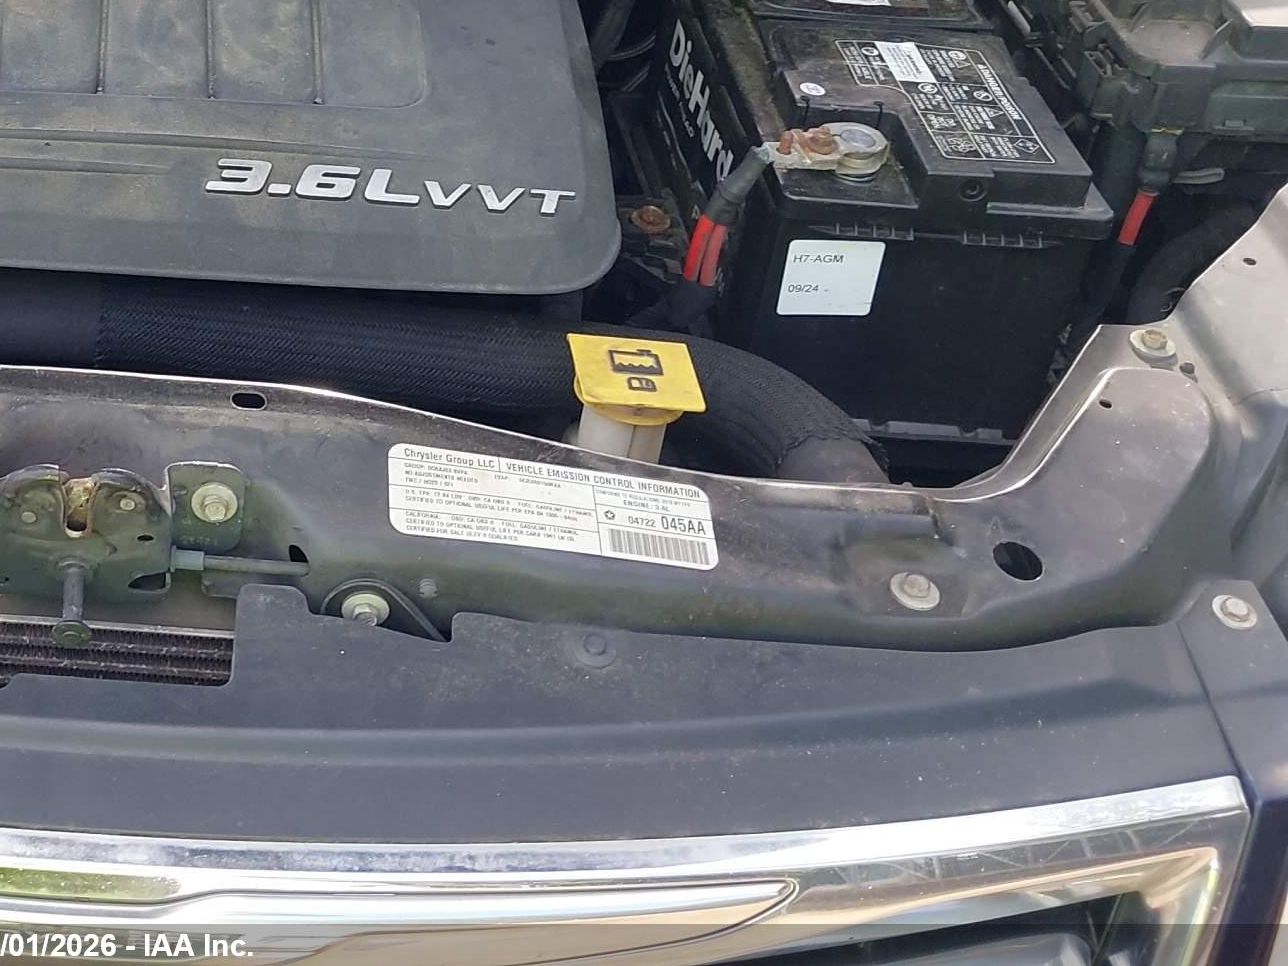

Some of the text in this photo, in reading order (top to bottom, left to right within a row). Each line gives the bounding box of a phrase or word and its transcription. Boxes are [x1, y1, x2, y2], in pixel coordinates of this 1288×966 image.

[667, 18, 734, 182] DieHard
[205, 157, 576, 216] 3.6L VVT
[793, 254, 844, 265] H7-AGM
[788, 283, 819, 294] 09/24
[404, 447, 495, 468] Chrysler Group LLC
[506, 462, 544, 475] VEHICLE
[547, 468, 590, 482] EMISSION
[593, 475, 635, 489] CONTROL
[638, 482, 700, 498] INFORMATION
[628, 515, 706, 535] 04722 045AA
